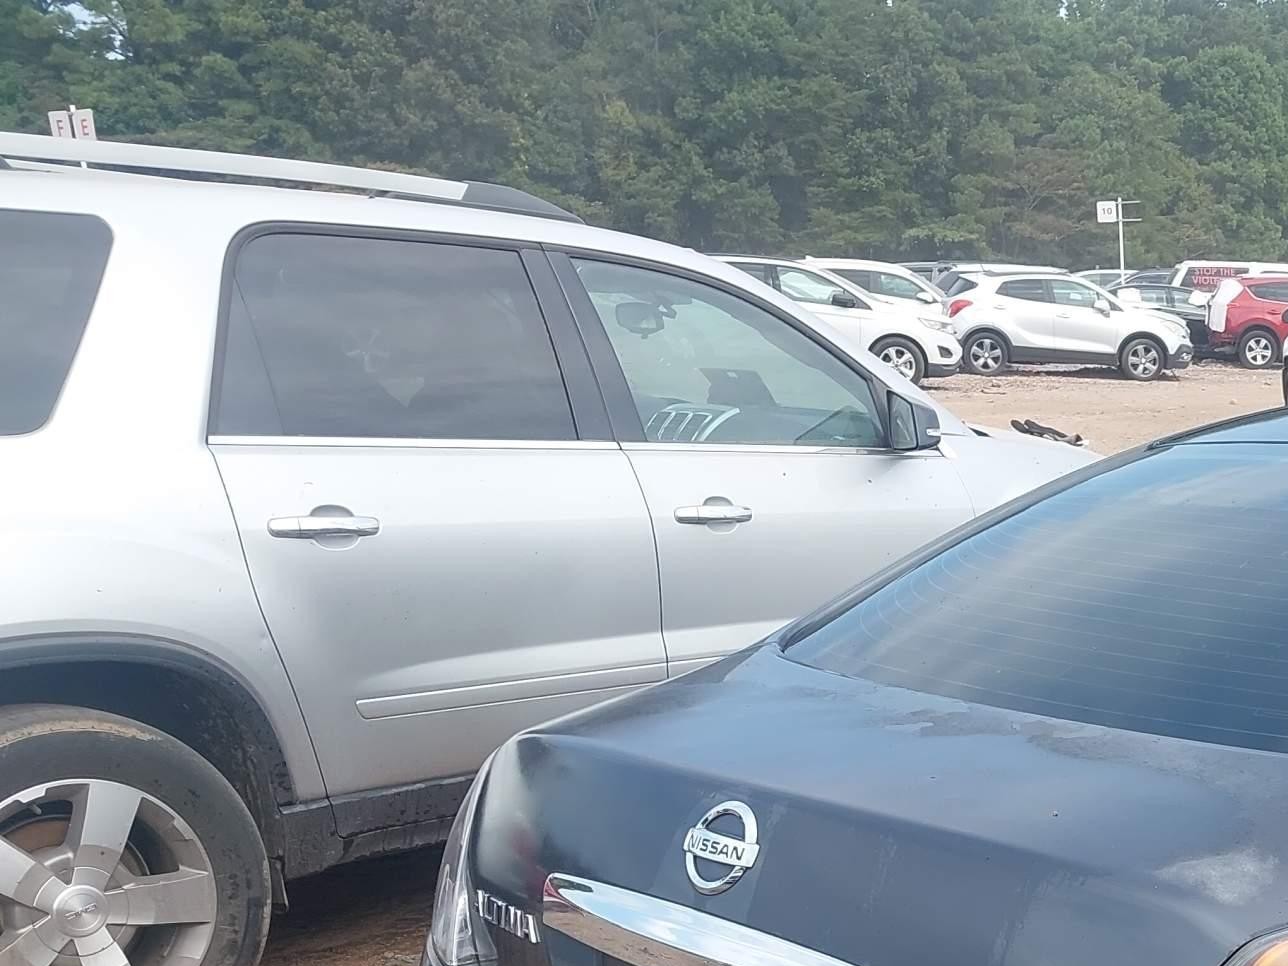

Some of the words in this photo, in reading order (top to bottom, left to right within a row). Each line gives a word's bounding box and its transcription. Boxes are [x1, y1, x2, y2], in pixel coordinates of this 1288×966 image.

[56, 120, 64, 136] F
[80, 119, 89, 136] E
[1102, 207, 1113, 215] 10
[1194, 267, 1217, 276] STOP
[1220, 268, 1235, 277] THE
[688, 833, 745, 861] NISSAN
[474, 889, 542, 944] ALTIMA
